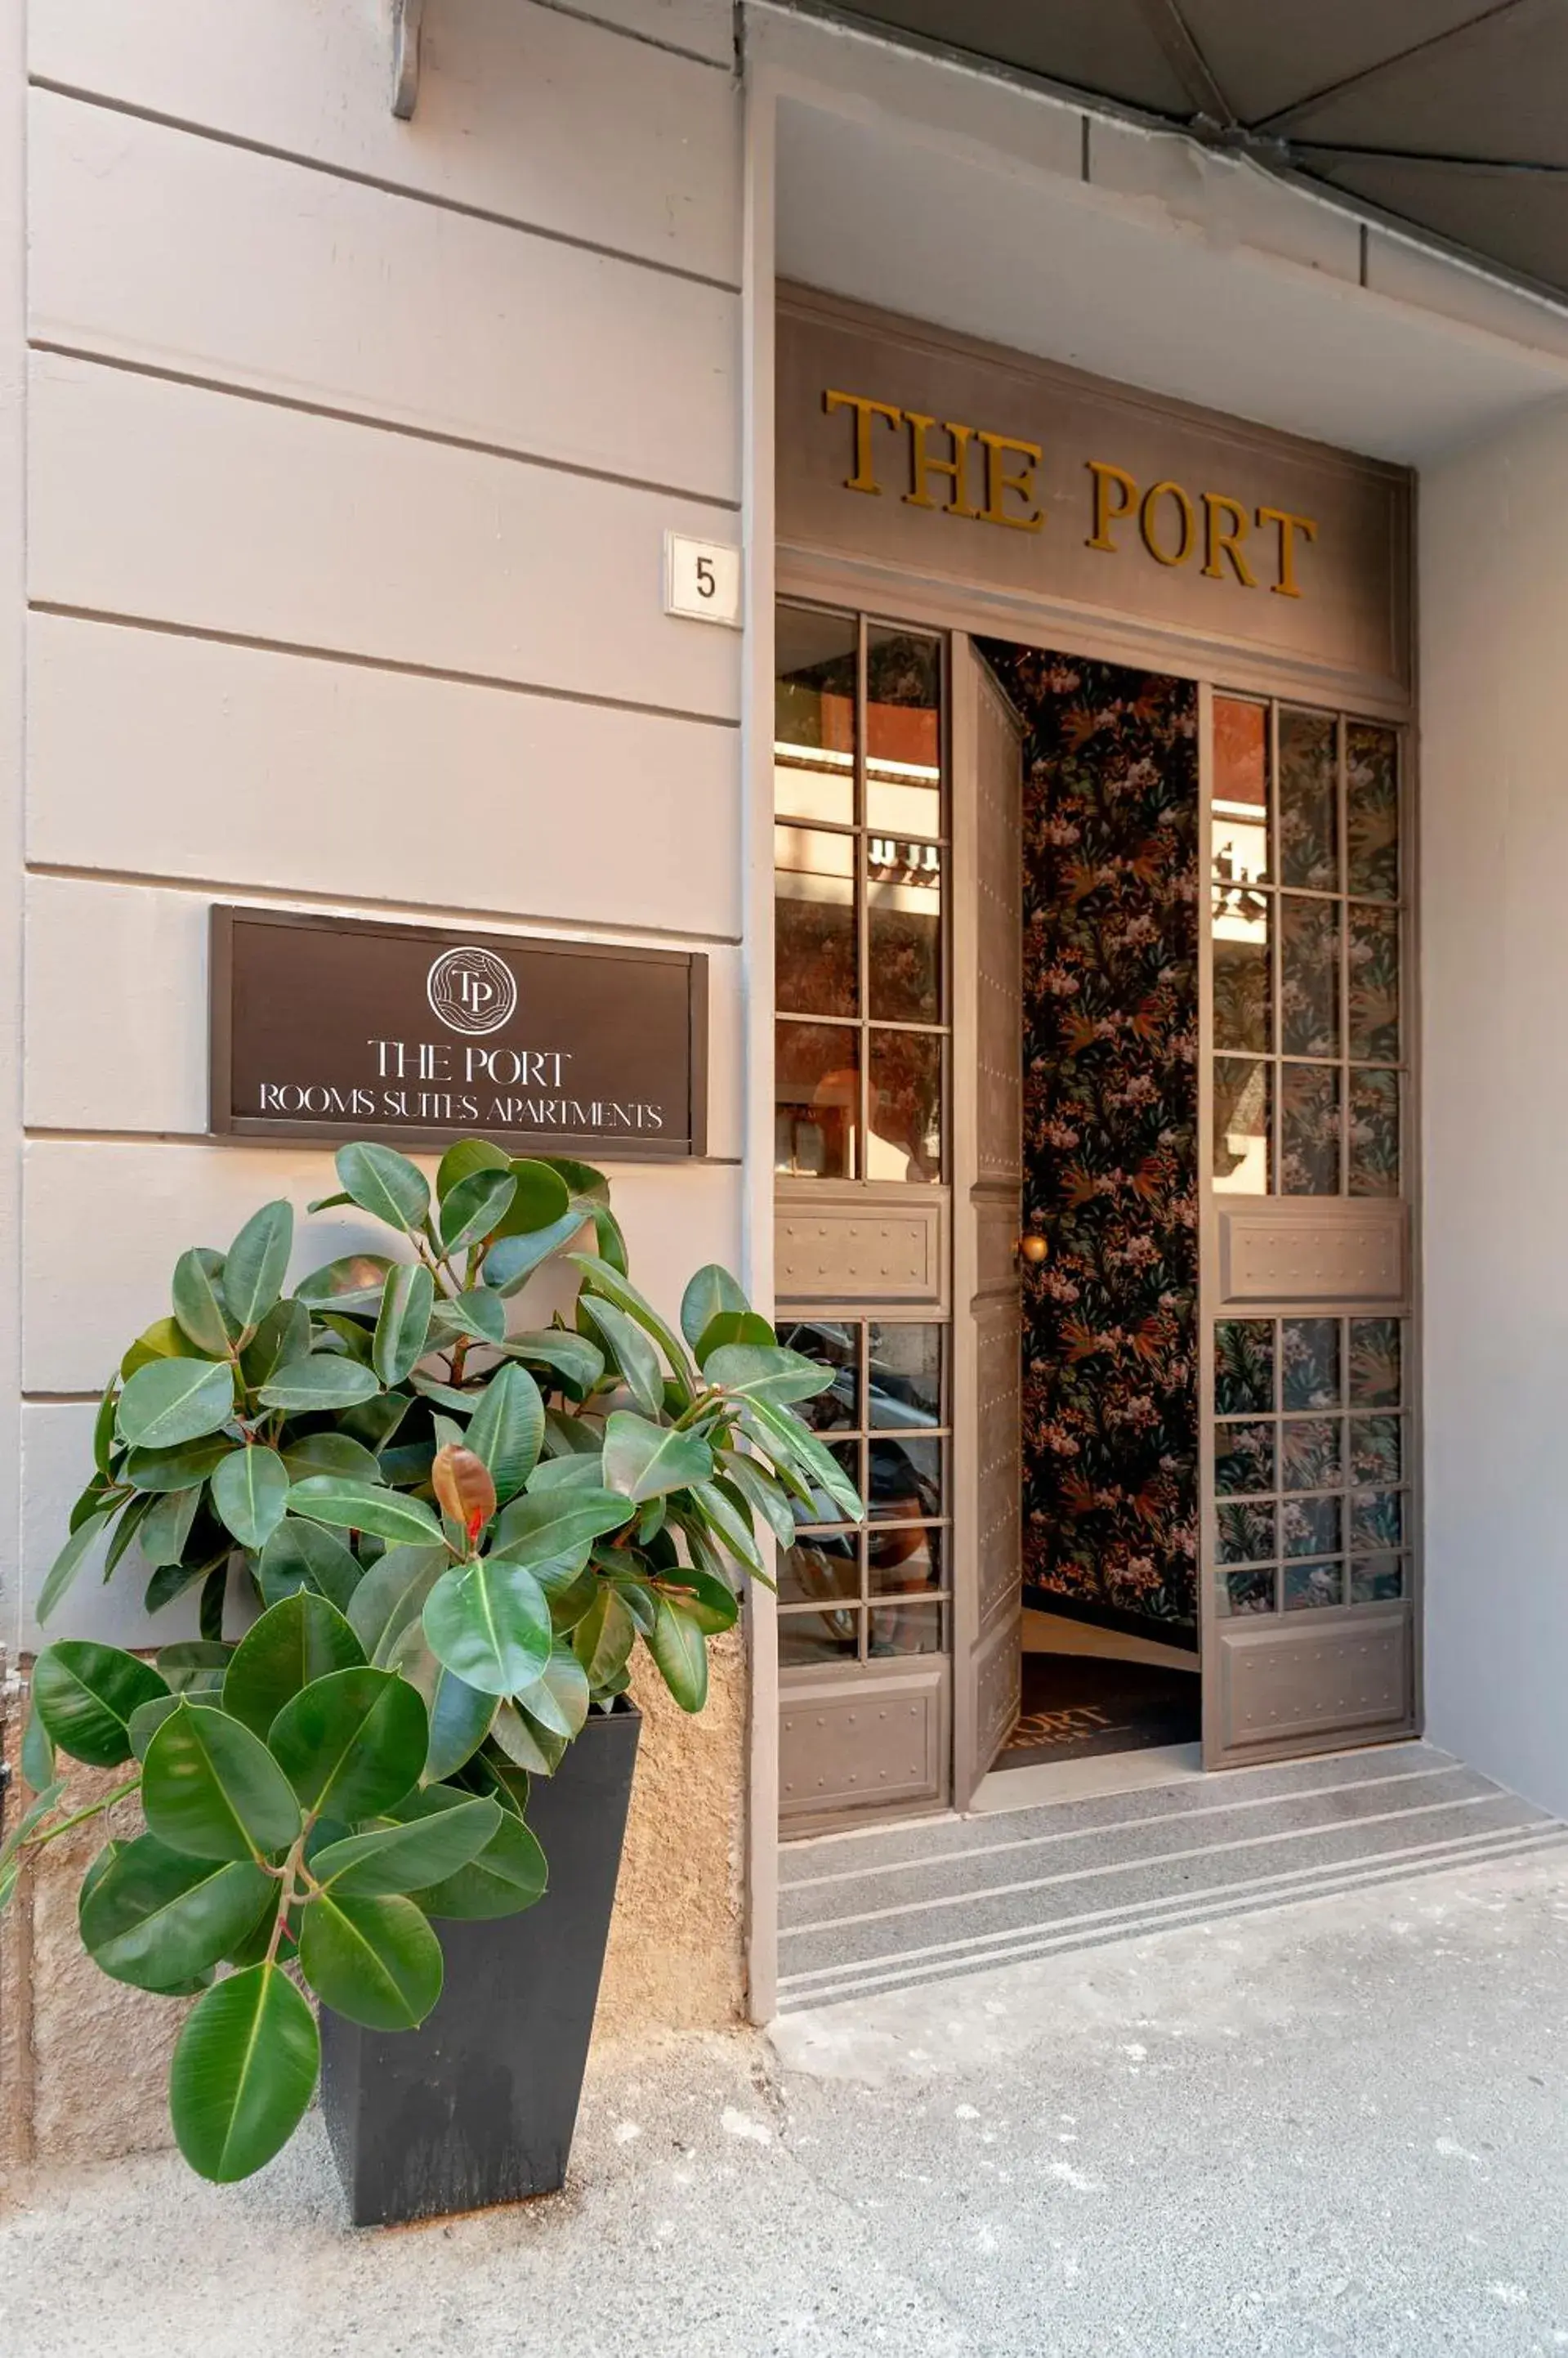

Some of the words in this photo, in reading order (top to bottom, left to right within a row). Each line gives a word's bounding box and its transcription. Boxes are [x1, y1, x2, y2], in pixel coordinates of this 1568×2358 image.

[822, 389, 1043, 533] THE
[1083, 461, 1318, 597] PORT
[697, 557, 715, 597] 5
[368, 1040, 452, 1081] THE
[466, 1047, 573, 1087] PORT
[260, 1084, 375, 1115] ROOMS
[382, 1091, 480, 1120] SUITES
[486, 1098, 663, 1129] APARTMENTS
[1016, 1706, 1111, 1733] ORT
